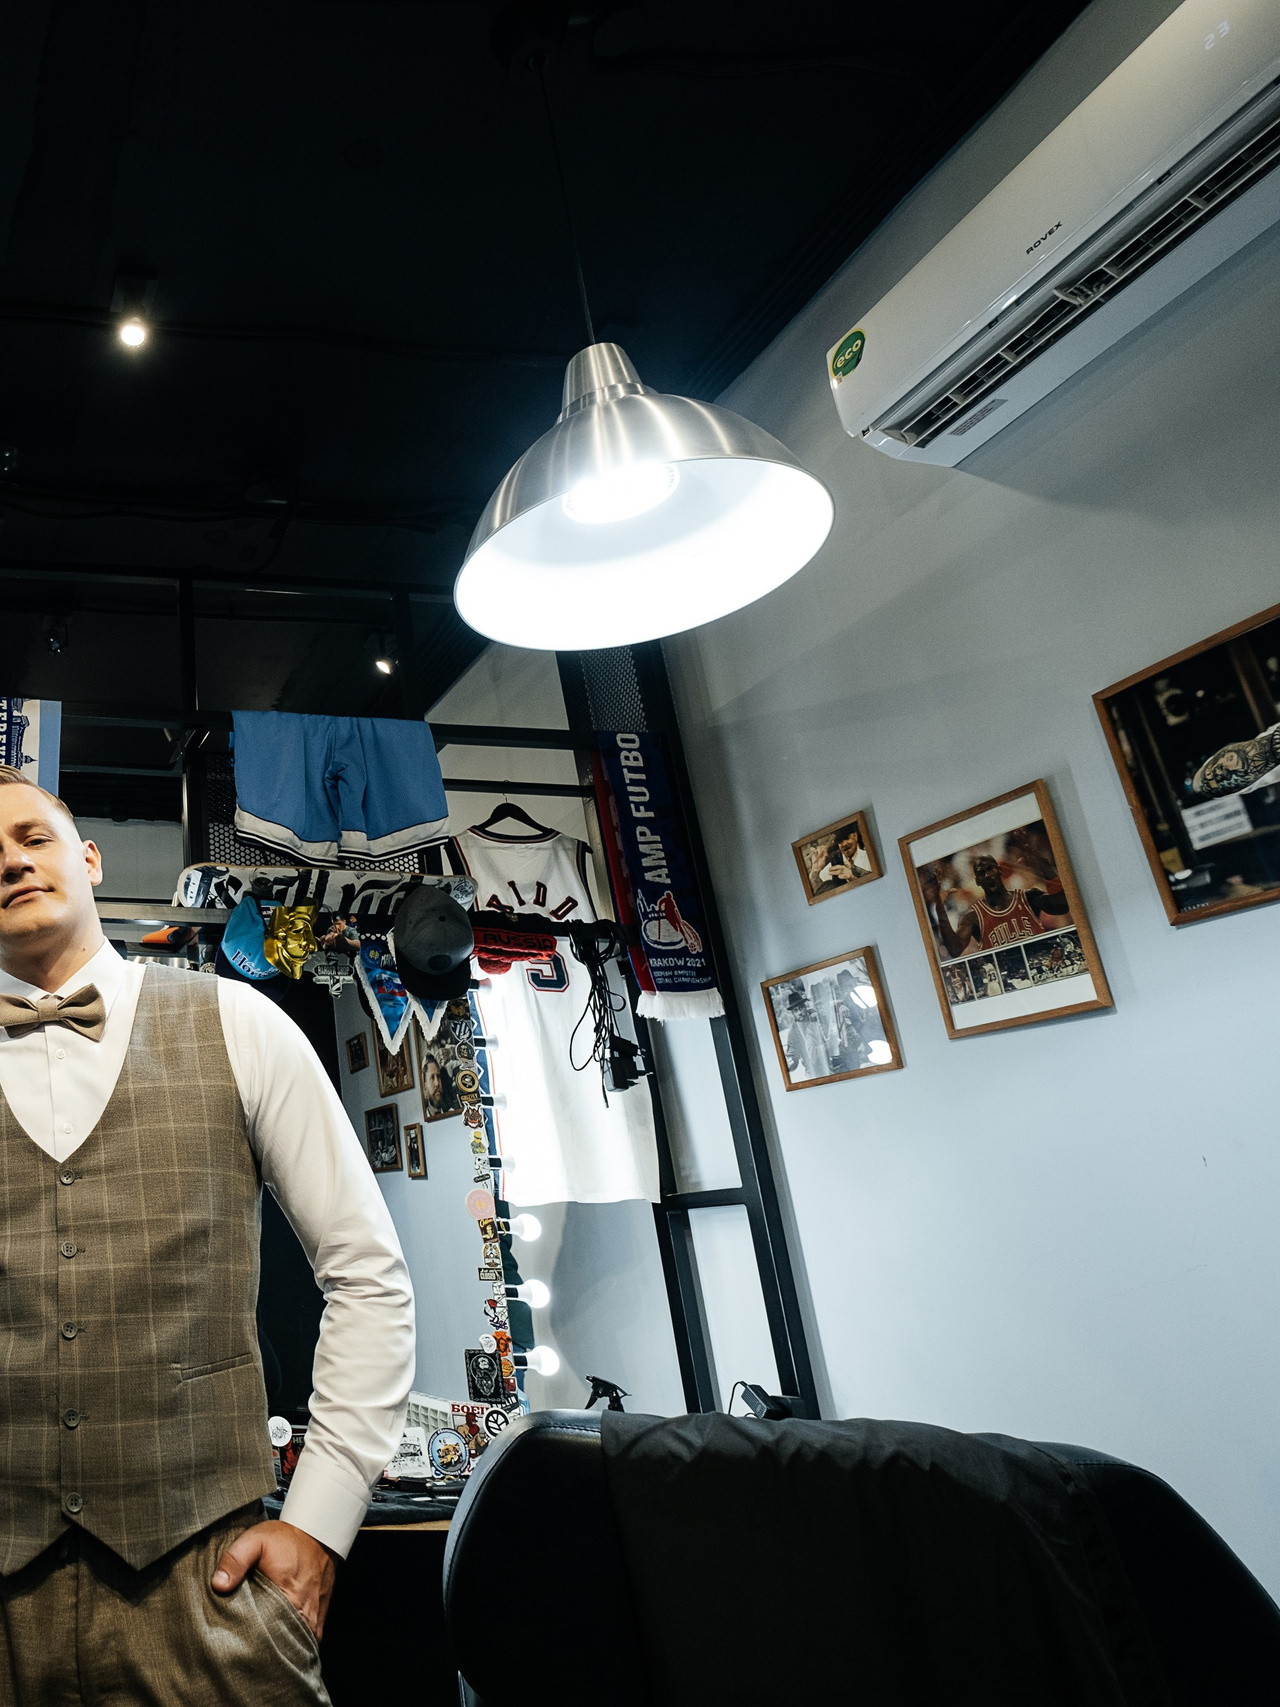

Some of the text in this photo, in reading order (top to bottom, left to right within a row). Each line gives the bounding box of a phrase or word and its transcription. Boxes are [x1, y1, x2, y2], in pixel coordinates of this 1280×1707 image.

[1204, 21, 1229, 50] 23
[1025, 221, 1062, 254] ROVEX
[836, 339, 862, 368] eco
[616, 732, 671, 884] AMP FUTBO
[486, 880, 579, 921] KIDD
[483, 932, 555, 950] RUSSIA
[988, 916, 1034, 947] BULLS
[686, 957, 706, 967] 2021
[988, 970, 997, 981] 23
